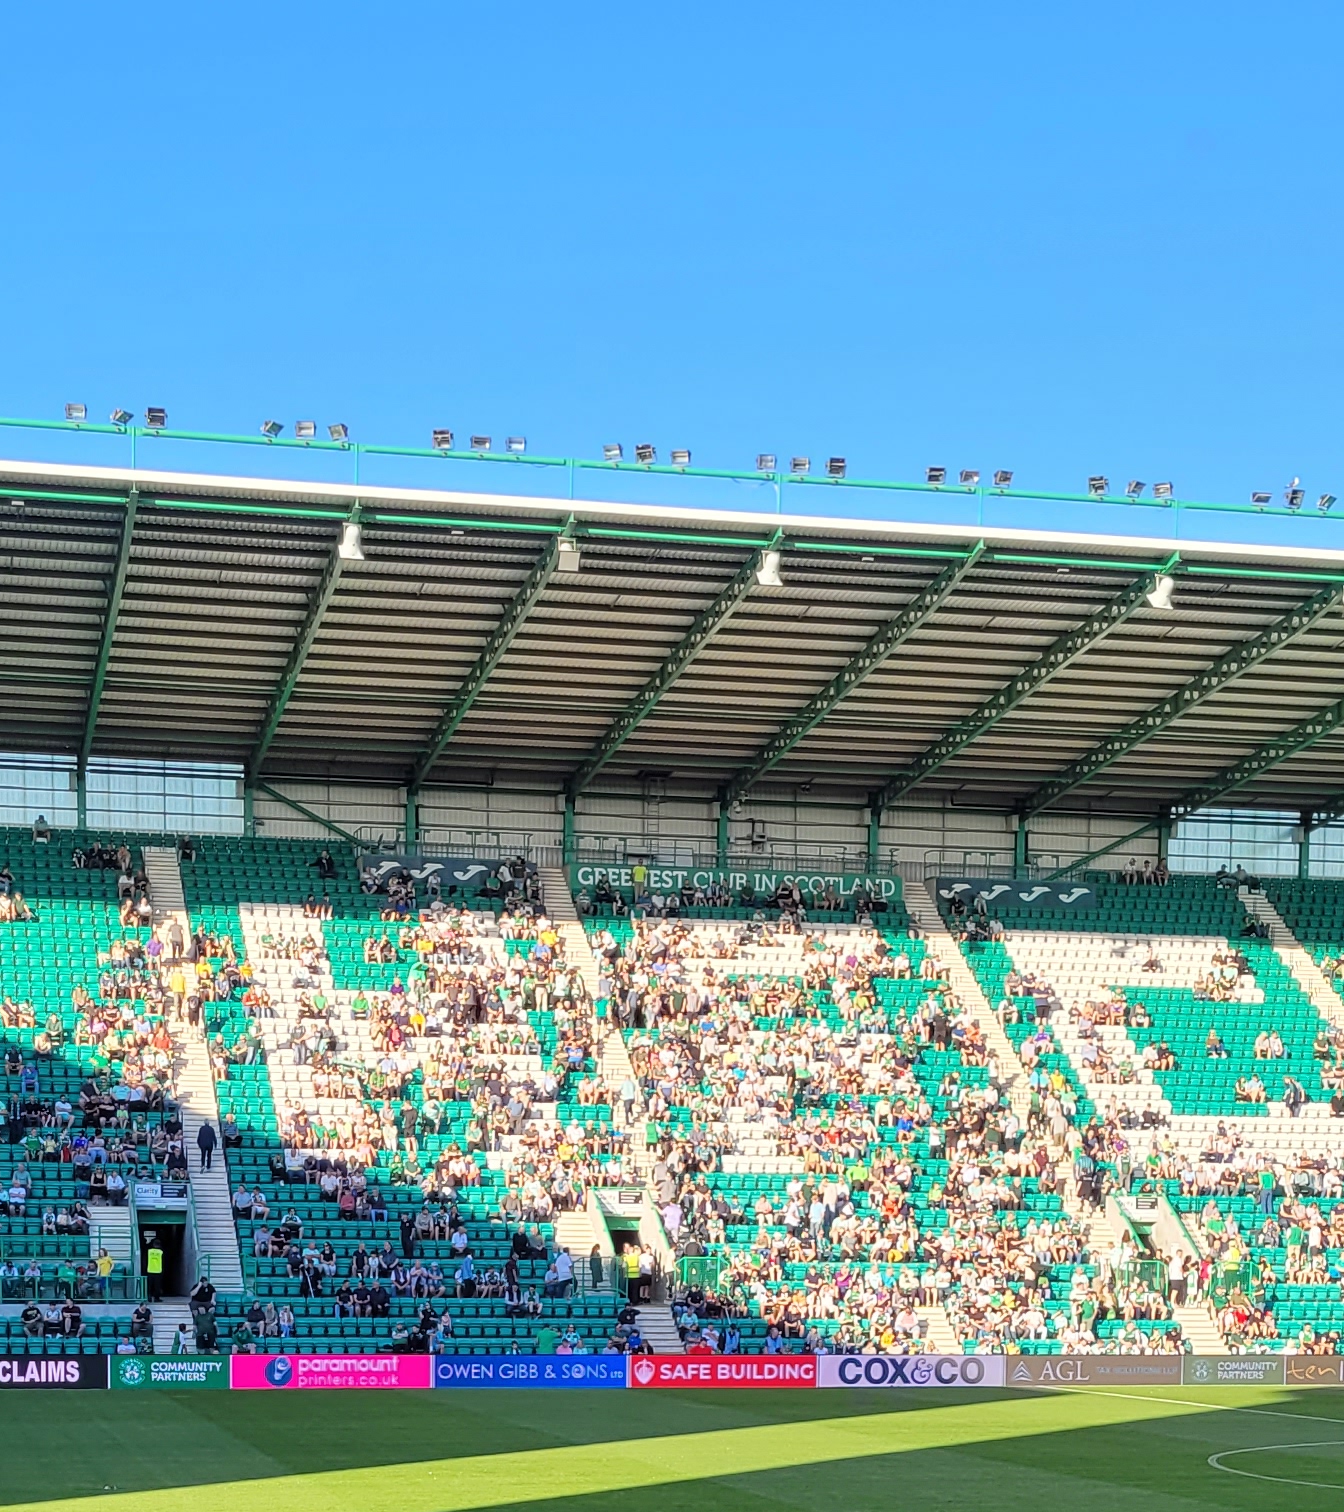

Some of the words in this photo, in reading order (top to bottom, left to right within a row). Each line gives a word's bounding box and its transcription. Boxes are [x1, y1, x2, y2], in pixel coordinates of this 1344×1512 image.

[577, 867, 687, 889] GREEEST
[754, 874, 777, 892] IN
[151, 1362, 222, 1372] COMMUNITY
[298, 1357, 399, 1374] paramount
[438, 1364, 493, 1379] OWEN
[499, 1363, 538, 1379] GIBB
[545, 1363, 556, 1378] &
[561, 1363, 607, 1379] SONS
[660, 1363, 711, 1380] SAFE
[717, 1363, 814, 1380] BUILDING
[839, 1357, 984, 1384] COX&CO
[1038, 1361, 1090, 1380] AGL
[1218, 1362, 1277, 1371] COMMUNITY
[151, 1372, 206, 1382] PARTNERS
[299, 1373, 399, 1387] printers.co.uk
[1218, 1371, 1264, 1380] PARTNERS
